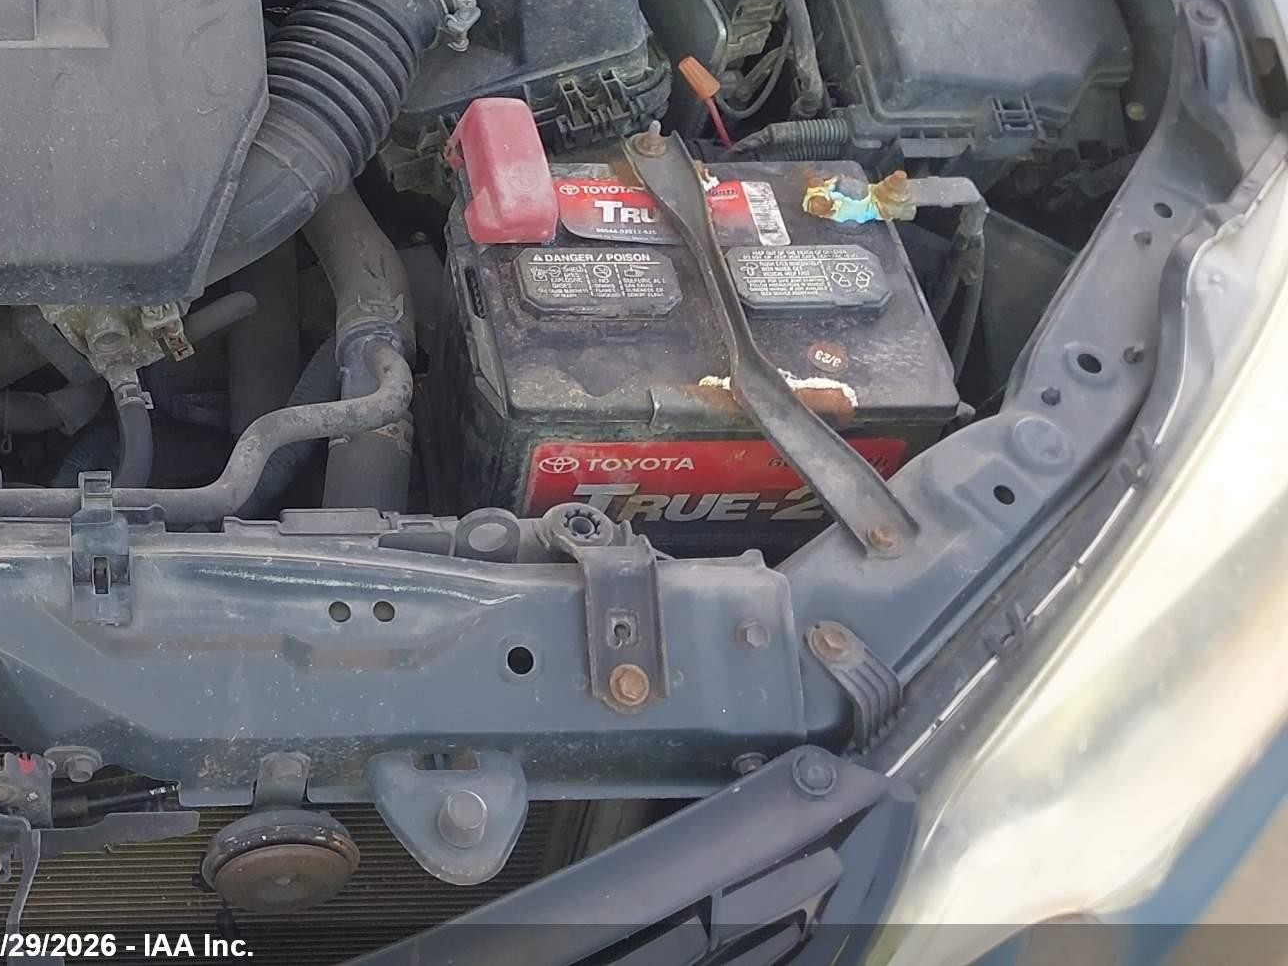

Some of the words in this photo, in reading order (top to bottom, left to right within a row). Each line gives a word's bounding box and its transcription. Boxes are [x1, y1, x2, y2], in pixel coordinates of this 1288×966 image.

[544, 253, 594, 262] DANGER
[606, 253, 651, 262] POISON
[586, 457, 695, 472] TOYOTA
